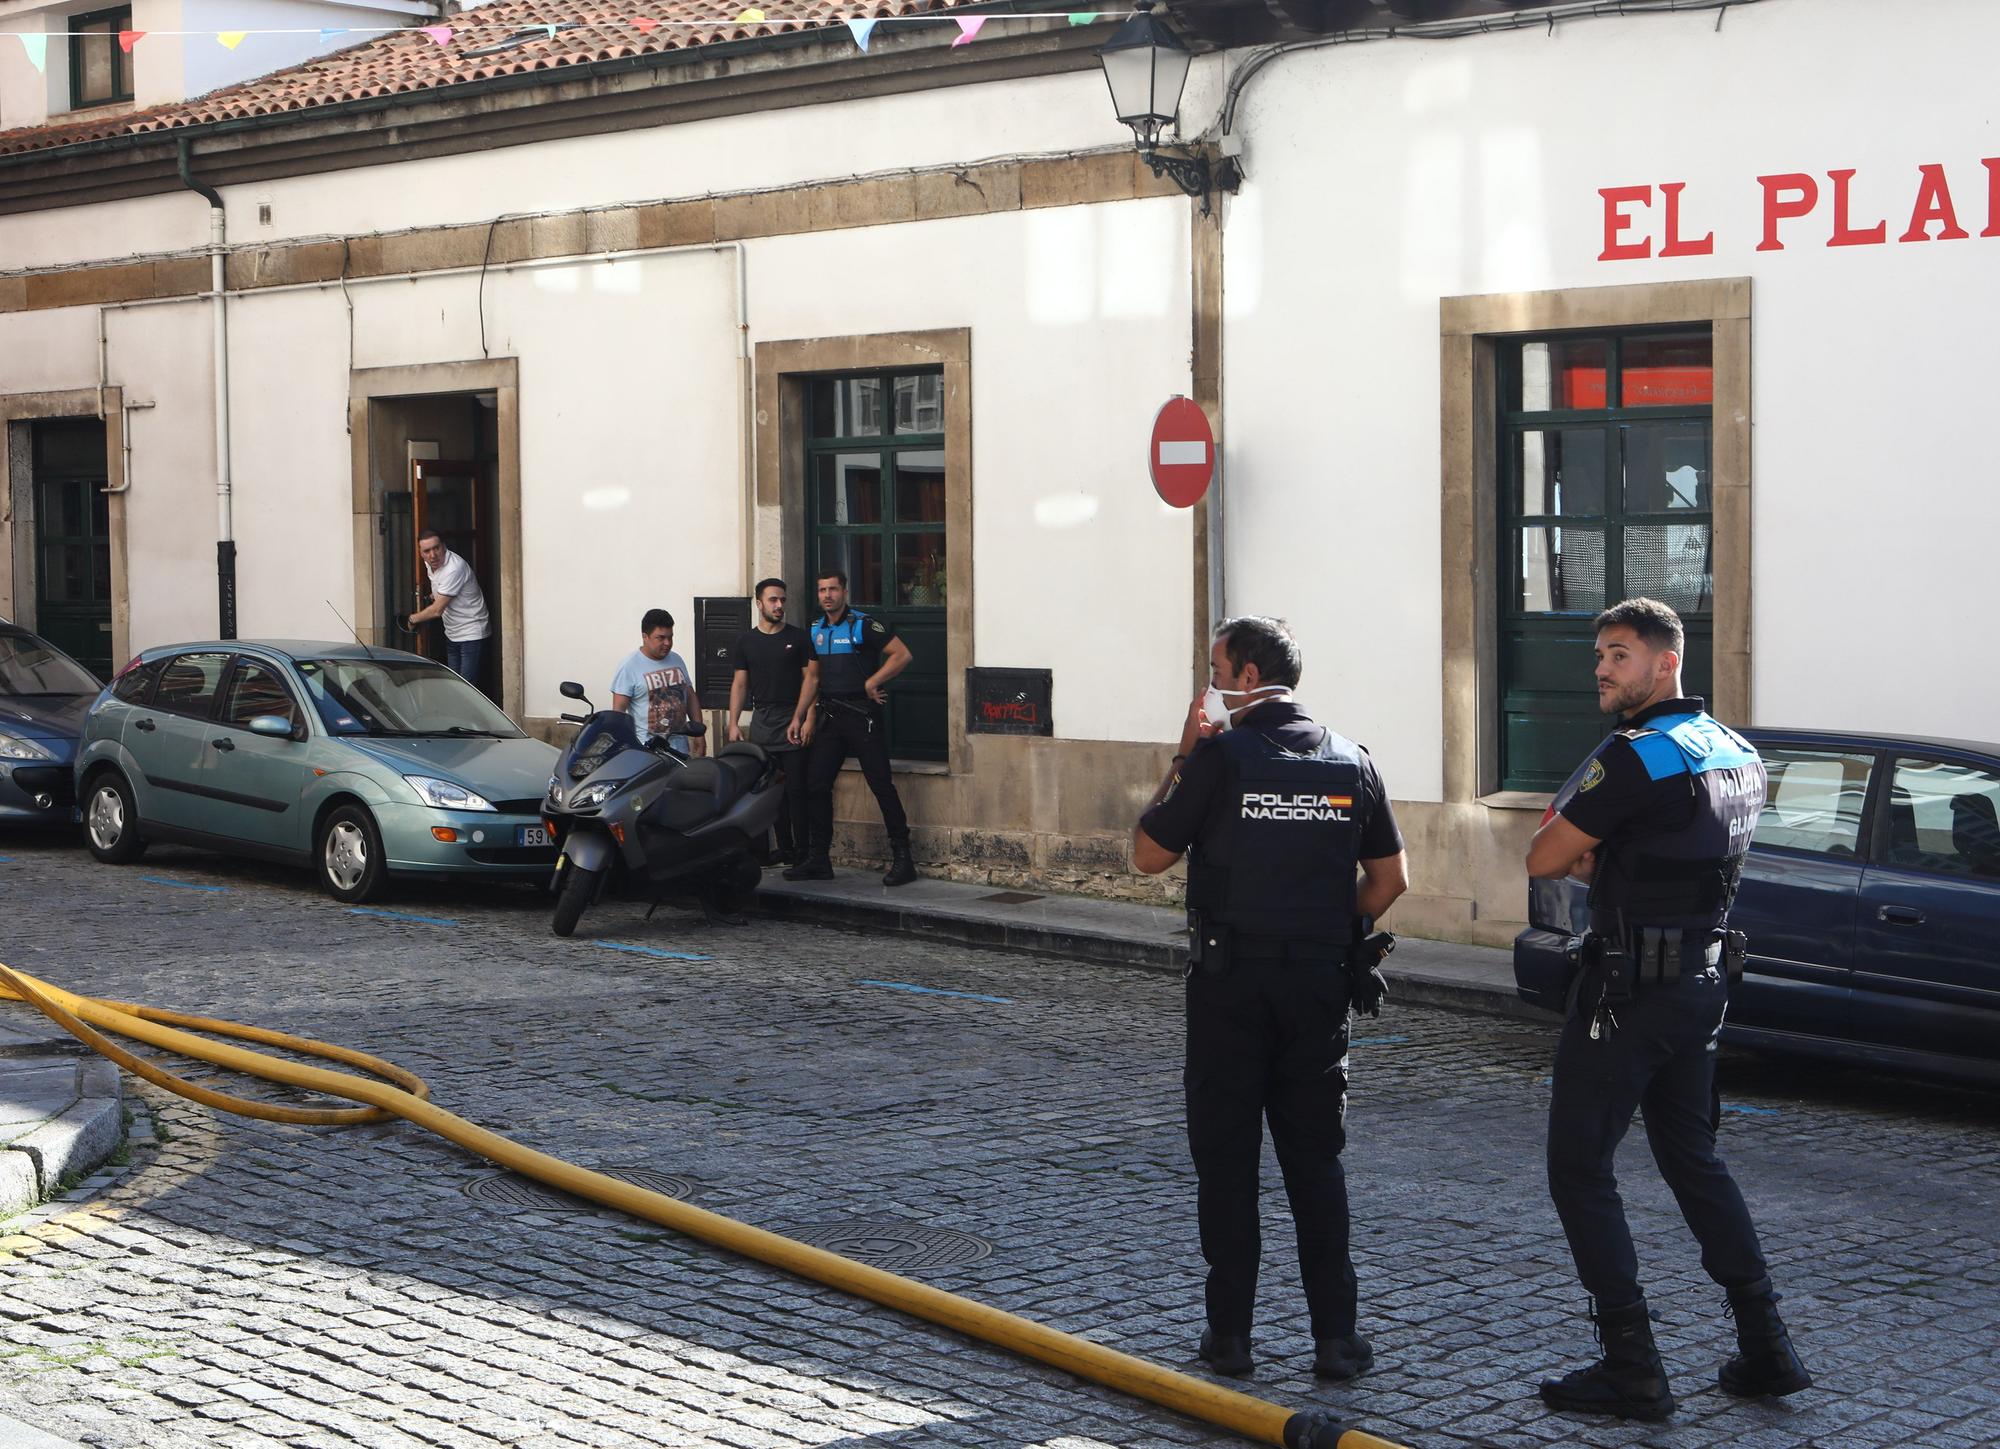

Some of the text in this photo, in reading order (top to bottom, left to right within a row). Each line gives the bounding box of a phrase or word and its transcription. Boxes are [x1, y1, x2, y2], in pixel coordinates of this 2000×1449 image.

[1597, 182, 1714, 261] EL
[645, 669, 686, 691] IBIZA
[1242, 793, 1331, 807] POLICIA
[1241, 807, 1351, 821] NACIONAL
